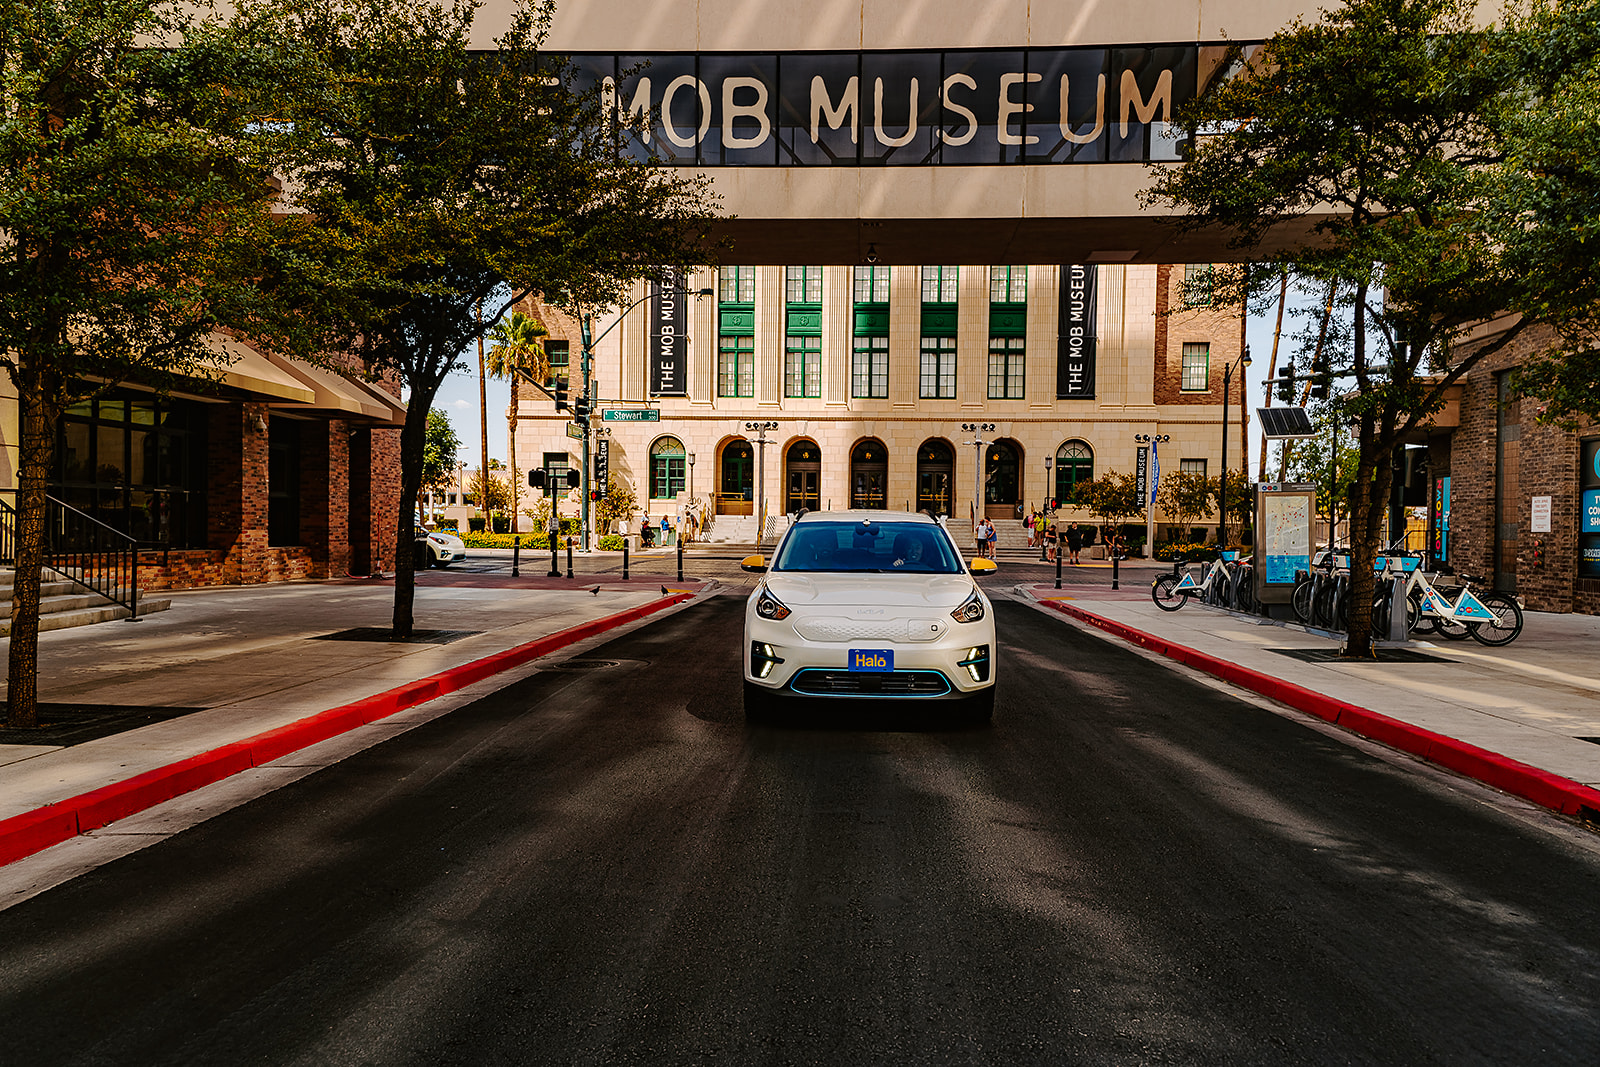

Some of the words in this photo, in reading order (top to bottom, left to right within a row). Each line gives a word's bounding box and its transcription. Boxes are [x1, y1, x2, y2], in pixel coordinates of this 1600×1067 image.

[601, 75, 770, 148] MOB
[810, 69, 1173, 147] MUSEUM
[661, 265, 675, 320] MUSEU
[660, 325, 675, 356] MOB
[1069, 326, 1084, 358] MOB
[661, 361, 674, 390] THE
[1069, 363, 1083, 393] THE
[613, 410, 643, 420] Stewart
[1138, 448, 1146, 476] MUSEUM
